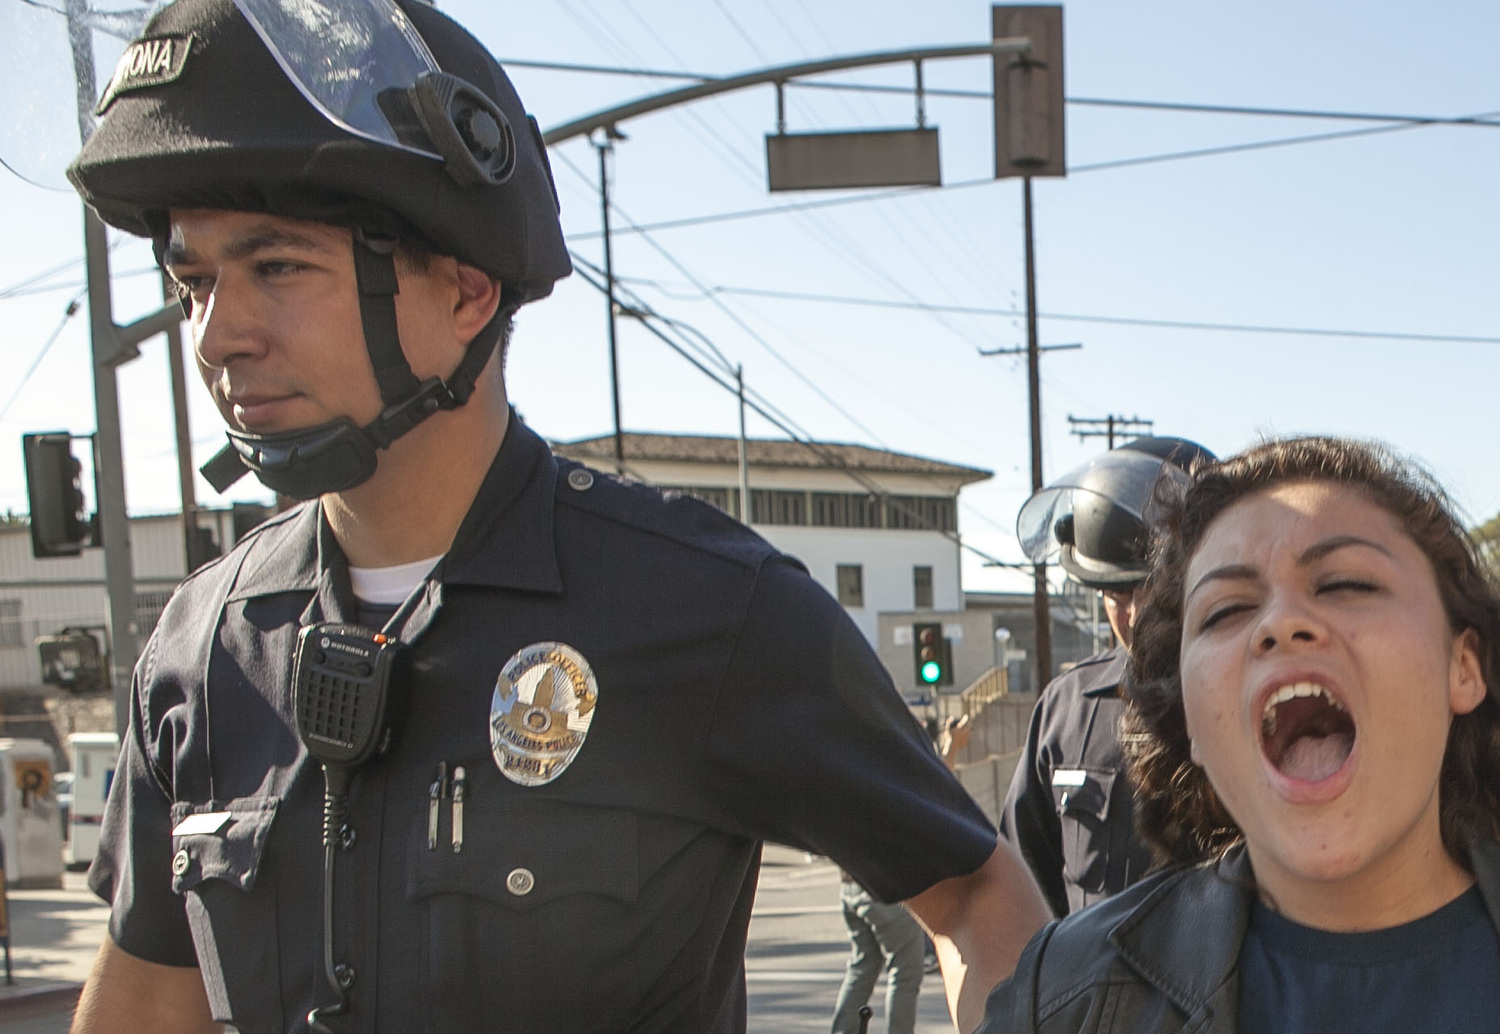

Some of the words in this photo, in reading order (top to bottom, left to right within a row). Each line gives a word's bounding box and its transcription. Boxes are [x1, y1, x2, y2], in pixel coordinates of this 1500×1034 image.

[330, 641, 370, 658] MOTOROLA
[508, 651, 547, 681] POLICE
[552, 652, 588, 697] OFFICER
[505, 729, 543, 751] ANGELES
